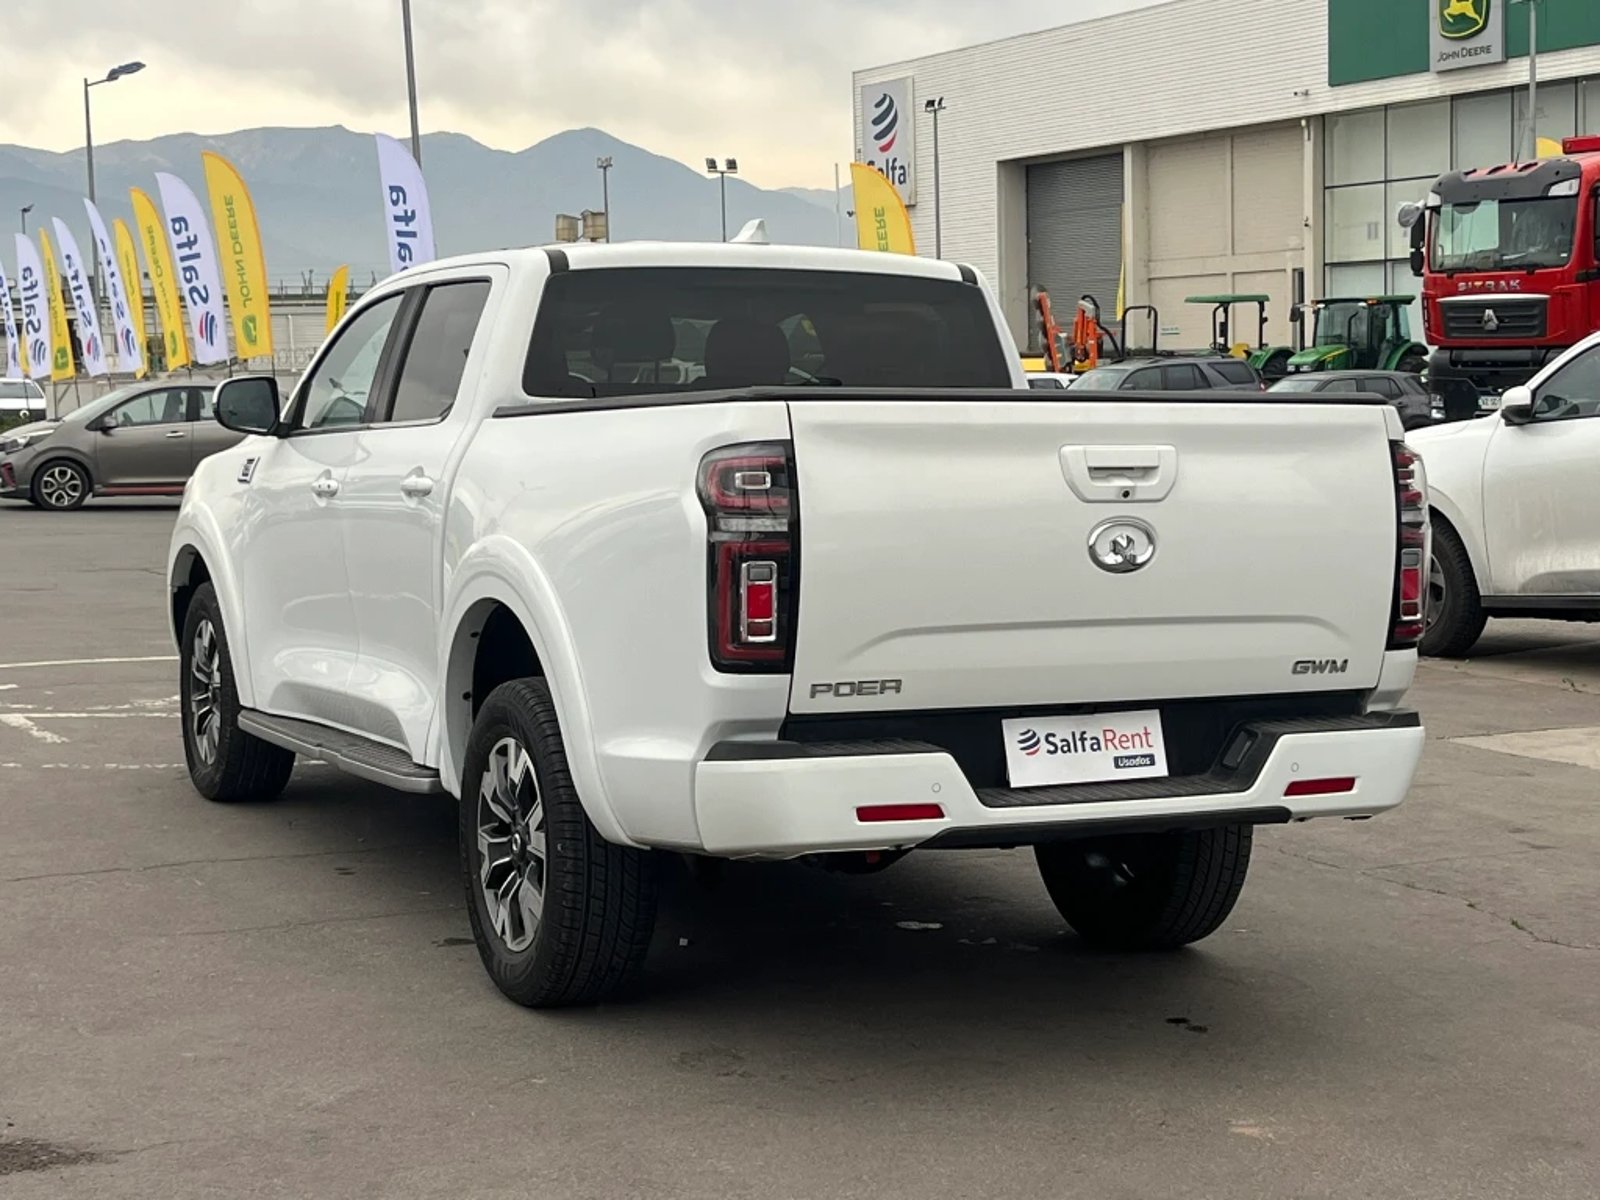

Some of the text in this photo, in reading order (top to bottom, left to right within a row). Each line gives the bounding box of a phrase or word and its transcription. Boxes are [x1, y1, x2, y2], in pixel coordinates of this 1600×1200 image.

[1437, 45, 1492, 63] JOHN DEERE
[867, 158, 907, 185] lfa
[1458, 279, 1521, 291] SITRAK
[1291, 659, 1348, 675] GWM
[809, 679, 902, 699] POER
[1118, 756, 1151, 767] Usados
